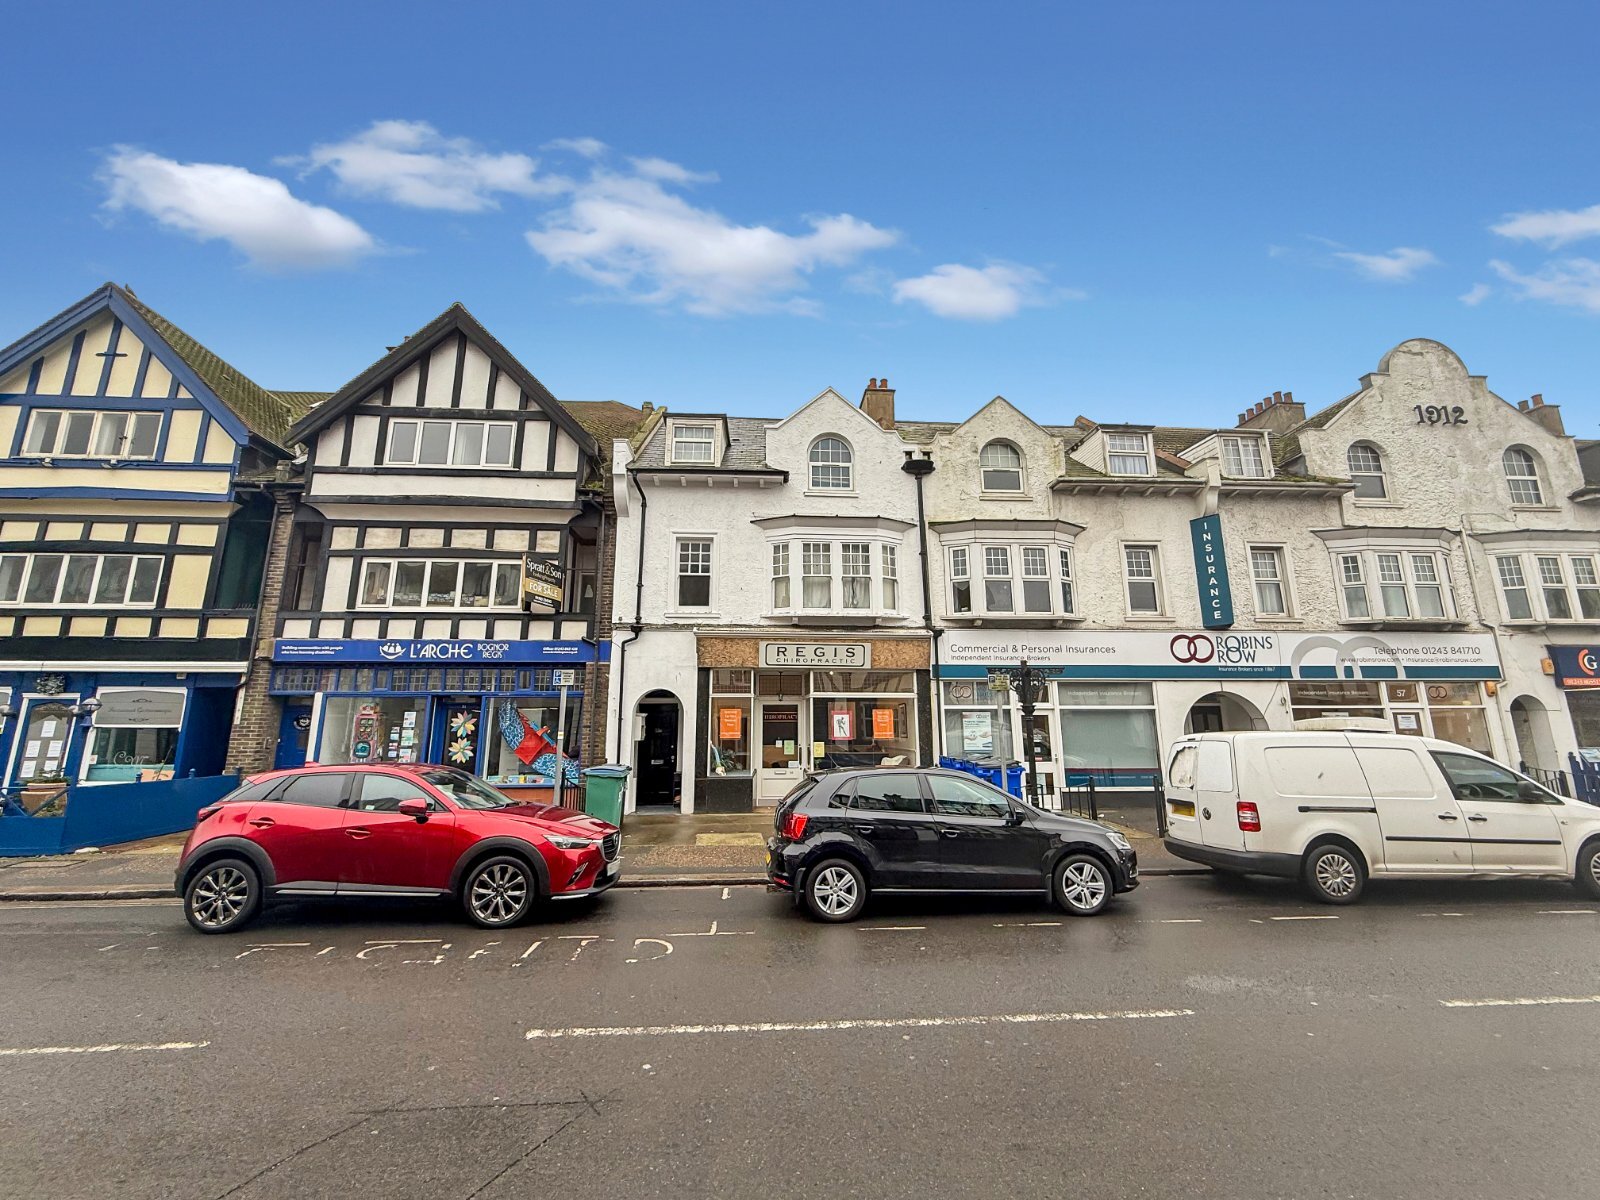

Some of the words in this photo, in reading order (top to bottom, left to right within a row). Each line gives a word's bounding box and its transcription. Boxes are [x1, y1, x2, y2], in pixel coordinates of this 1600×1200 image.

[1412, 404, 1469, 425] 1912
[526, 558, 545, 573] Spratt
[550, 567, 562, 580] Son
[1203, 522, 1222, 620] INSURANCE
[529, 582, 543, 593] FOR
[543, 586, 558, 598] SALE
[409, 643, 473, 659] L'ARCHE
[477, 643, 509, 651] BOGNOR
[950, 644, 1009, 653] Commercial
[1012, 645, 1018, 654] &
[1021, 644, 1062, 654] Personal
[1066, 645, 1116, 654] Insurances
[1215, 635, 1273, 651] ROBINS
[1373, 646, 1420, 656] Telephone
[1421, 646, 1448, 655] 01243
[1450, 646, 1481, 655] 841710
[482, 650, 502, 659] REGIS
[776, 646, 856, 658] REGIS
[1217, 648, 1256, 664] ROW
